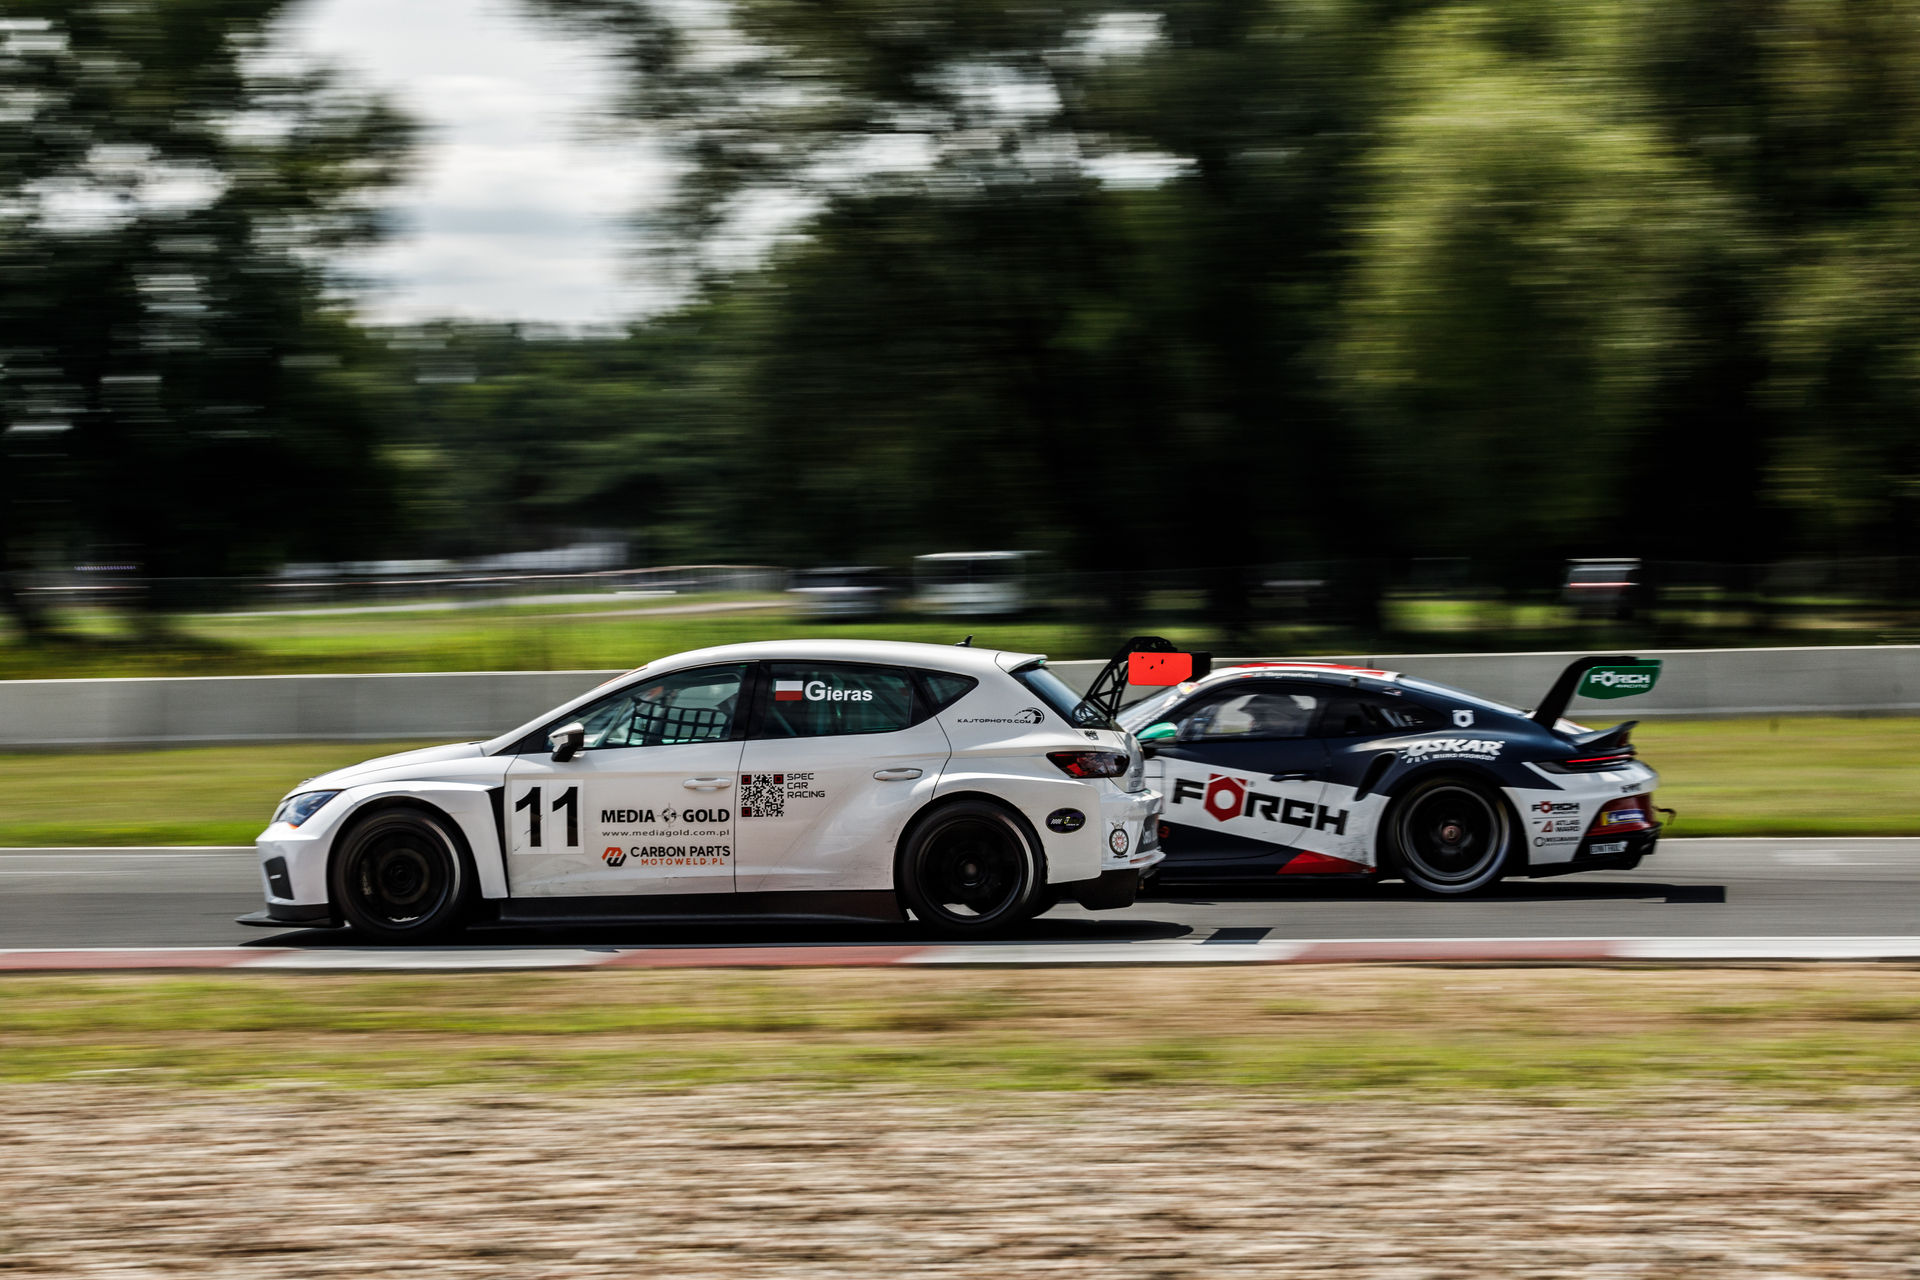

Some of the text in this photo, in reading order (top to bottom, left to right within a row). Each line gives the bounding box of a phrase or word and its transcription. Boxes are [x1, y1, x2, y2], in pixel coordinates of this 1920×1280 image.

[804, 680, 873, 701] Gieras
[957, 717, 1032, 725] KAJTOPHOTO.COM
[1406, 739, 1503, 757] OSKAR
[786, 772, 814, 781] SPEC
[786, 781, 808, 790] CAR
[786, 790, 826, 799] RACING
[515, 786, 579, 848] 11
[601, 808, 730, 823] MEDIA GOLD
[602, 828, 730, 838] www.mediagold.com.pl
[630, 845, 731, 857] CARBON PARTS
[641, 858, 725, 866] MOTOWELD.PL
